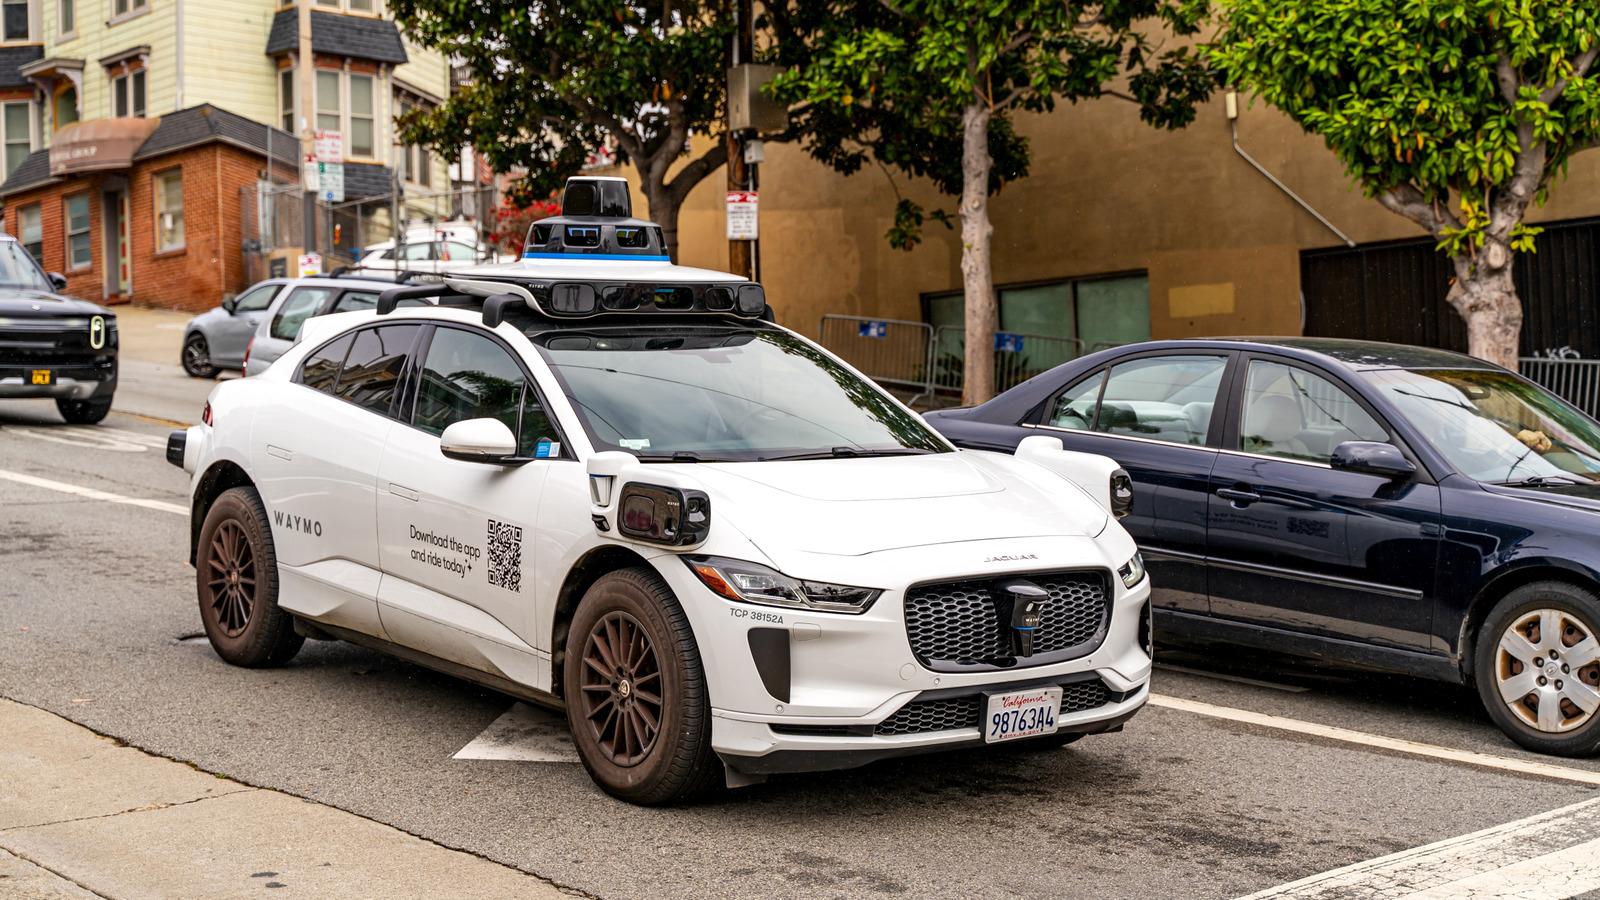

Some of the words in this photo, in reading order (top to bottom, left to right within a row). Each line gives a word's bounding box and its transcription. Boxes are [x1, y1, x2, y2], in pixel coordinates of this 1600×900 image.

[273, 509, 322, 537] WAYMO
[409, 524, 448, 549] Download
[449, 536, 463, 553] the
[463, 544, 481, 562] app
[410, 548, 426, 562] and
[427, 551, 442, 568] ride
[442, 556, 466, 578] today
[984, 554, 1039, 562] JAGUAR
[730, 607, 748, 618] TCP
[750, 611, 784, 624] 38152A
[1003, 695, 1047, 709] California
[991, 705, 1054, 736] 98763A4
